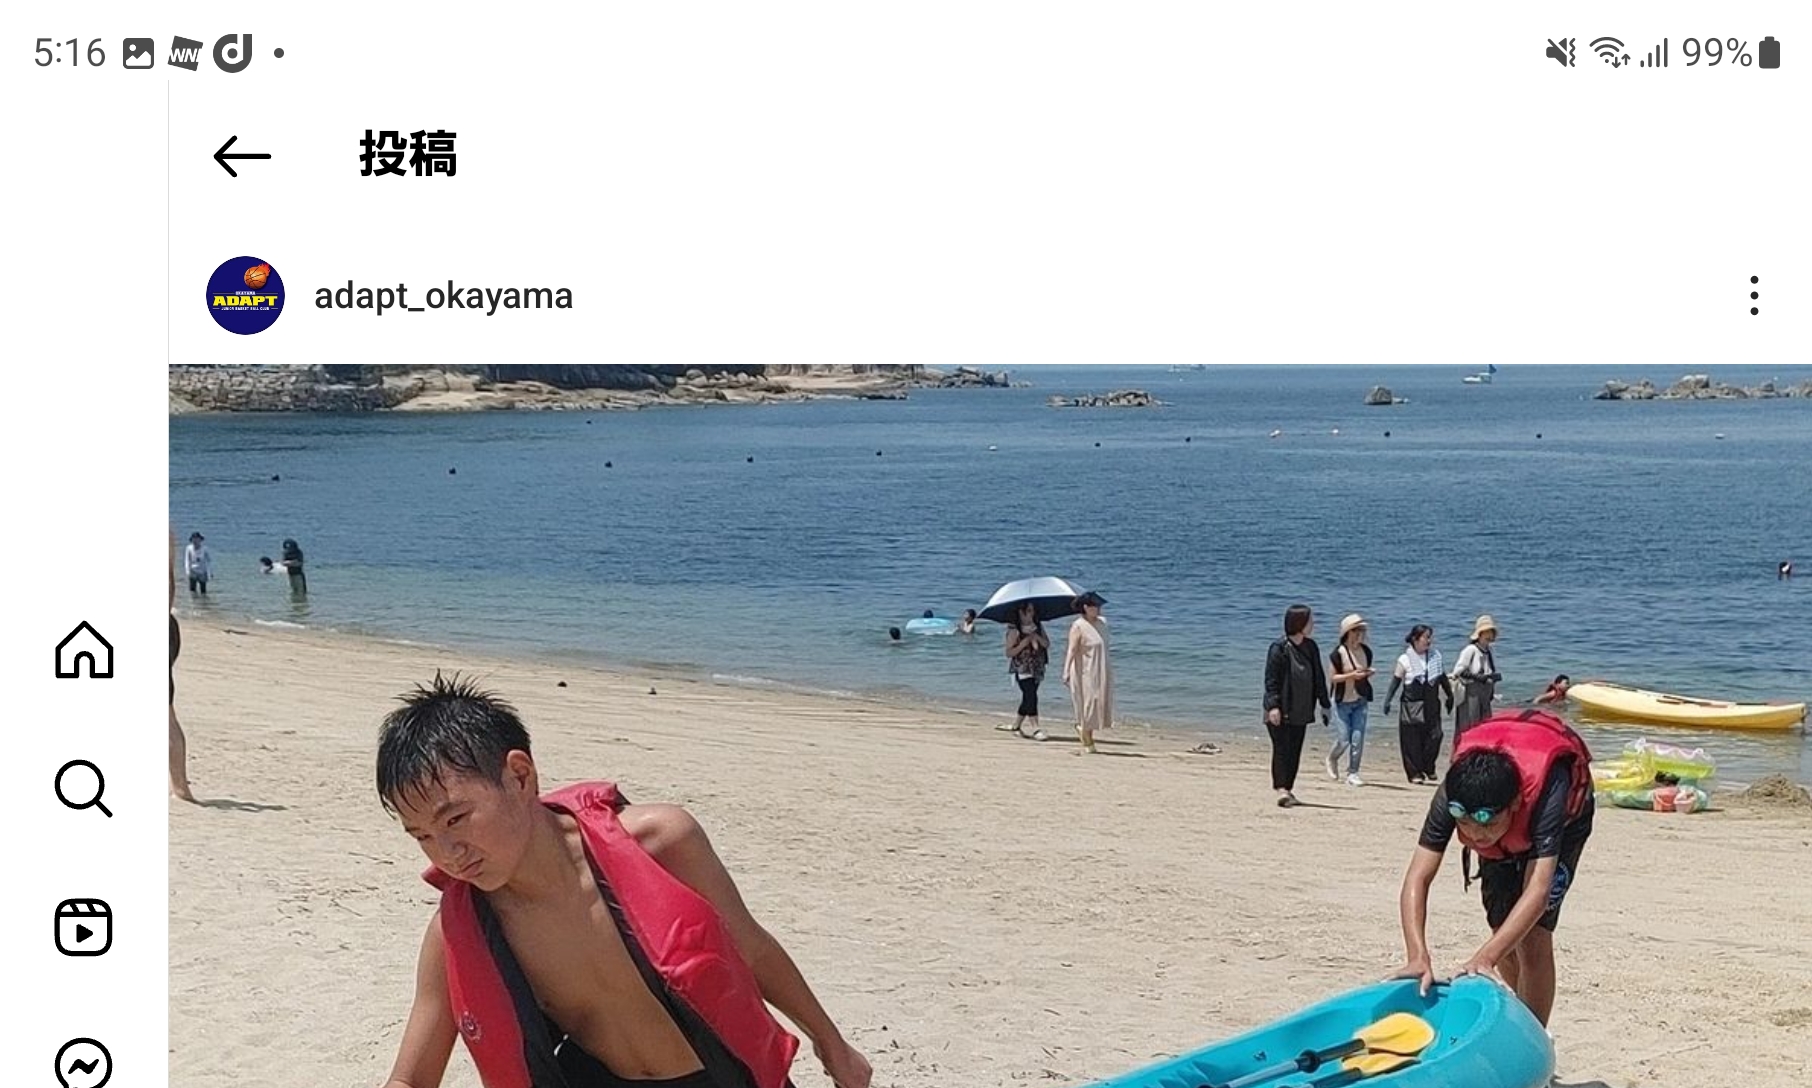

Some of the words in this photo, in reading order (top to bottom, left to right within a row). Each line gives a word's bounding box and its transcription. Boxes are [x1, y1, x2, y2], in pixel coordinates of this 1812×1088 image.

[34, 37, 106, 67] 5:16
[1682, 37, 1753, 67] 99%
[359, 129, 457, 177] 投稿
[212, 295, 278, 306] ADAPT
[314, 279, 573, 317] adapt_okayama
